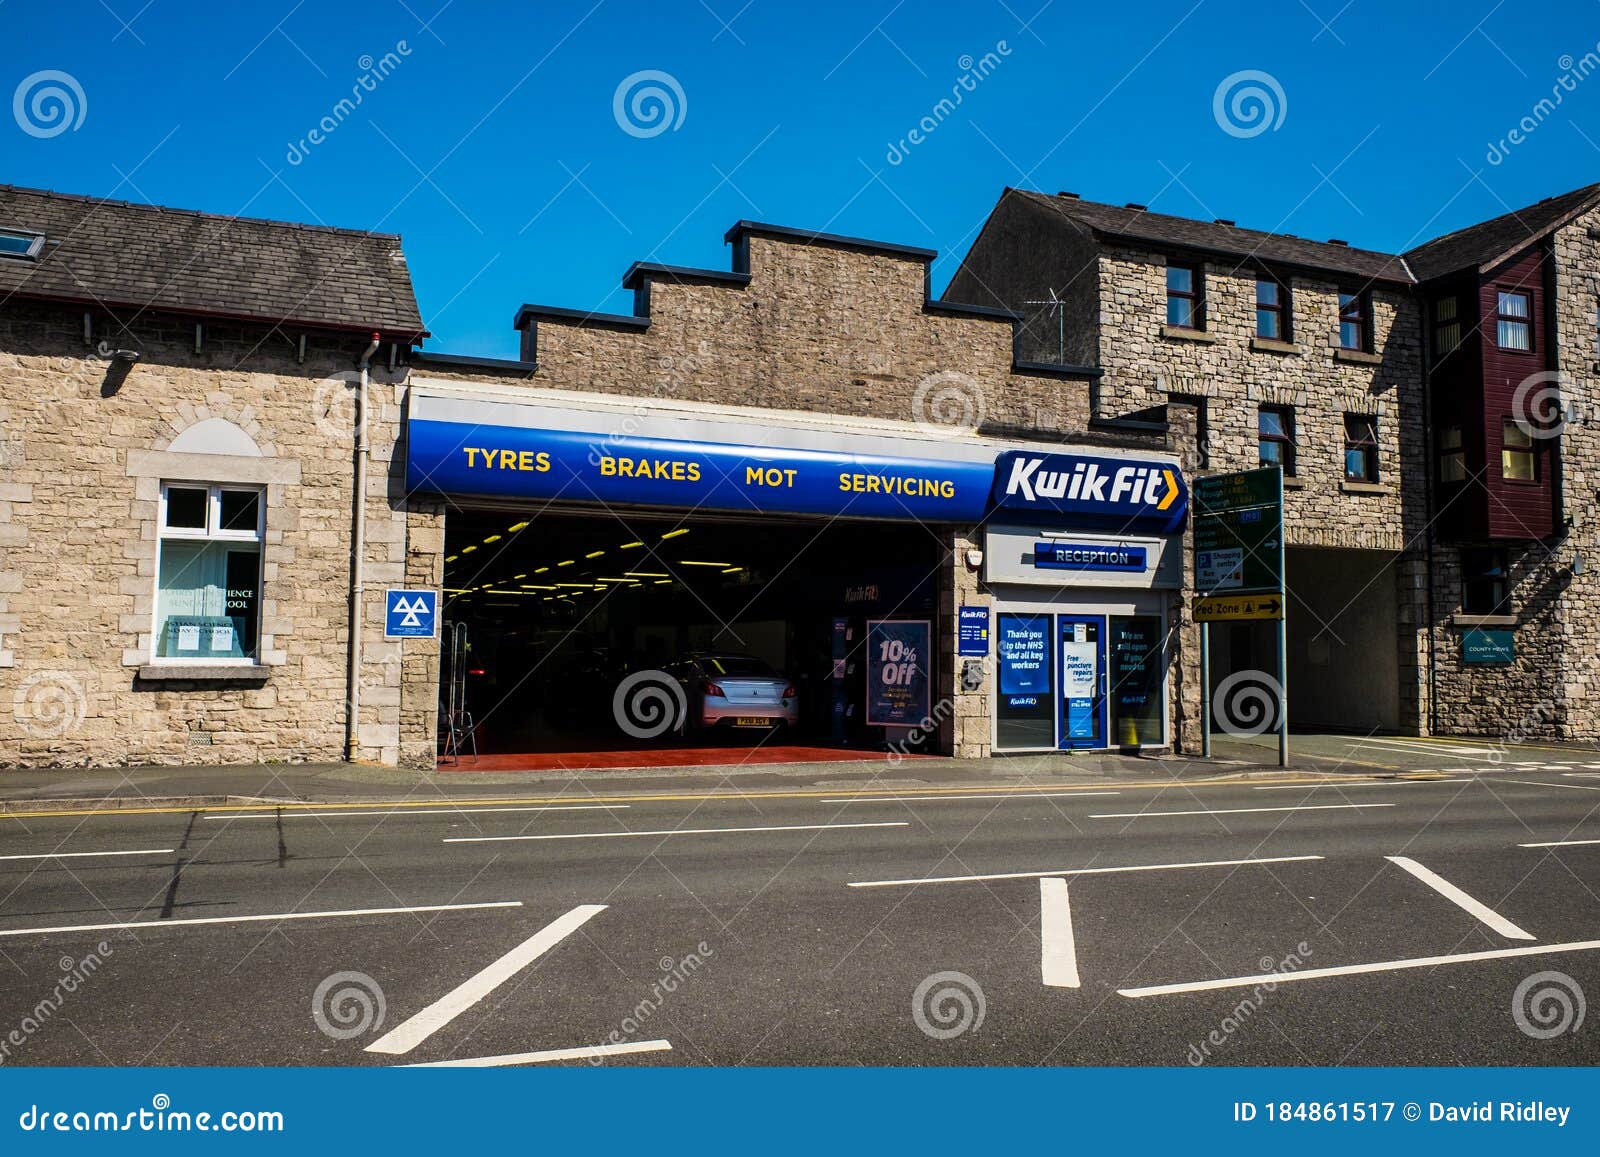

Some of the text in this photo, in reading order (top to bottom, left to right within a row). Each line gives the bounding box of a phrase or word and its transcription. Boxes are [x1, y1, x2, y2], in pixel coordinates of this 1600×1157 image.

[463, 447, 551, 473] TYRES
[600, 456, 701, 482] BRAKES
[746, 466, 797, 488] MOT
[1006, 457, 1164, 505] Kwik Fit
[838, 472, 955, 499] SERVICING
[1055, 549, 1129, 565] RECEPTION
[1196, 603, 1240, 614] Ped Zone
[1006, 630, 1043, 640] Thank you
[879, 639, 917, 662] 10%
[1015, 641, 1026, 649] the
[1027, 641, 1044, 649] NHS
[1006, 650, 1044, 661] and all key
[1066, 654, 1079, 662] Free
[1011, 661, 1040, 670] workers
[1072, 668, 1093, 677] repairs
[1010, 697, 1025, 705] Kwik
